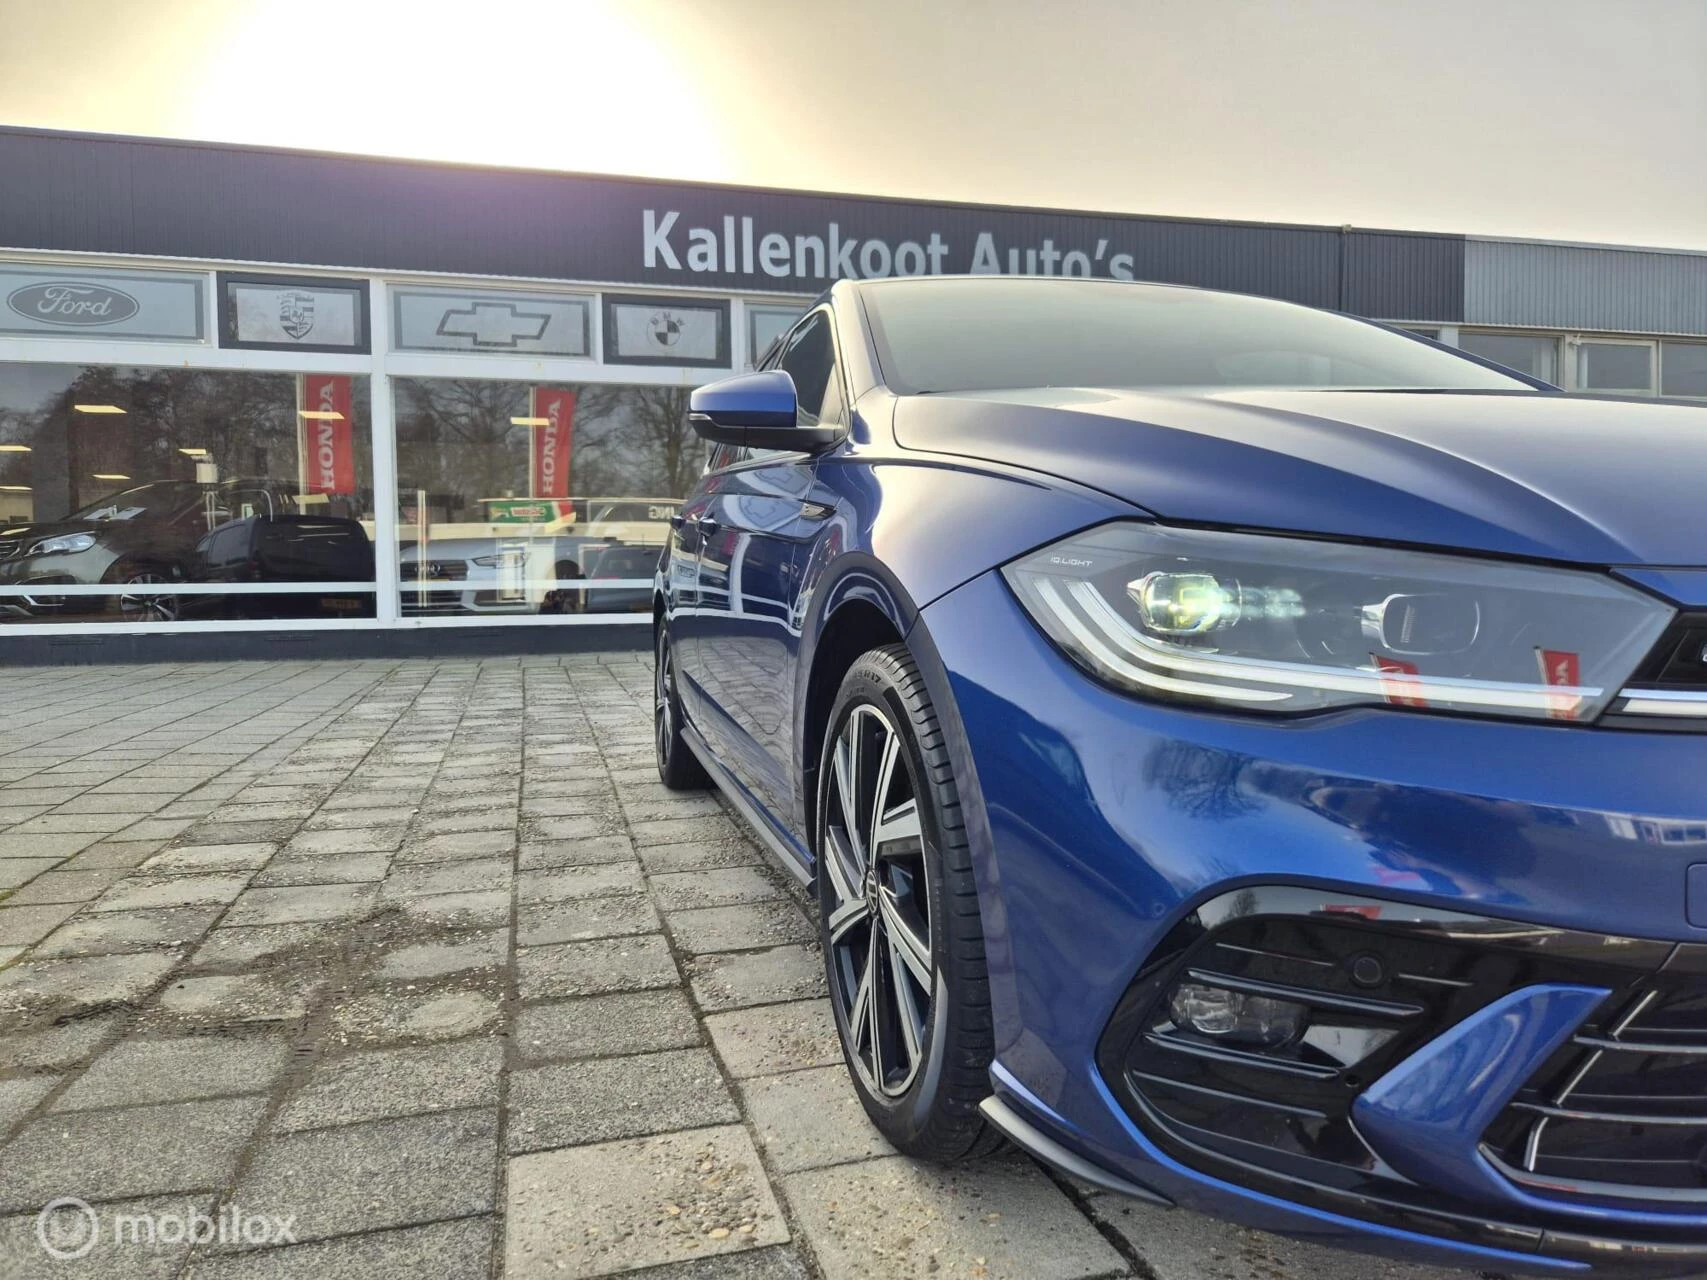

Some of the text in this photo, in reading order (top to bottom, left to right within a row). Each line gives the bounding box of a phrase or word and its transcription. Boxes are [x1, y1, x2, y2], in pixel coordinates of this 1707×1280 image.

[642, 209, 1136, 282] Kallenkoot Auto's
[37, 286, 113, 316] Ford
[318, 380, 335, 490] HONDA
[543, 398, 562, 494] HONDA
